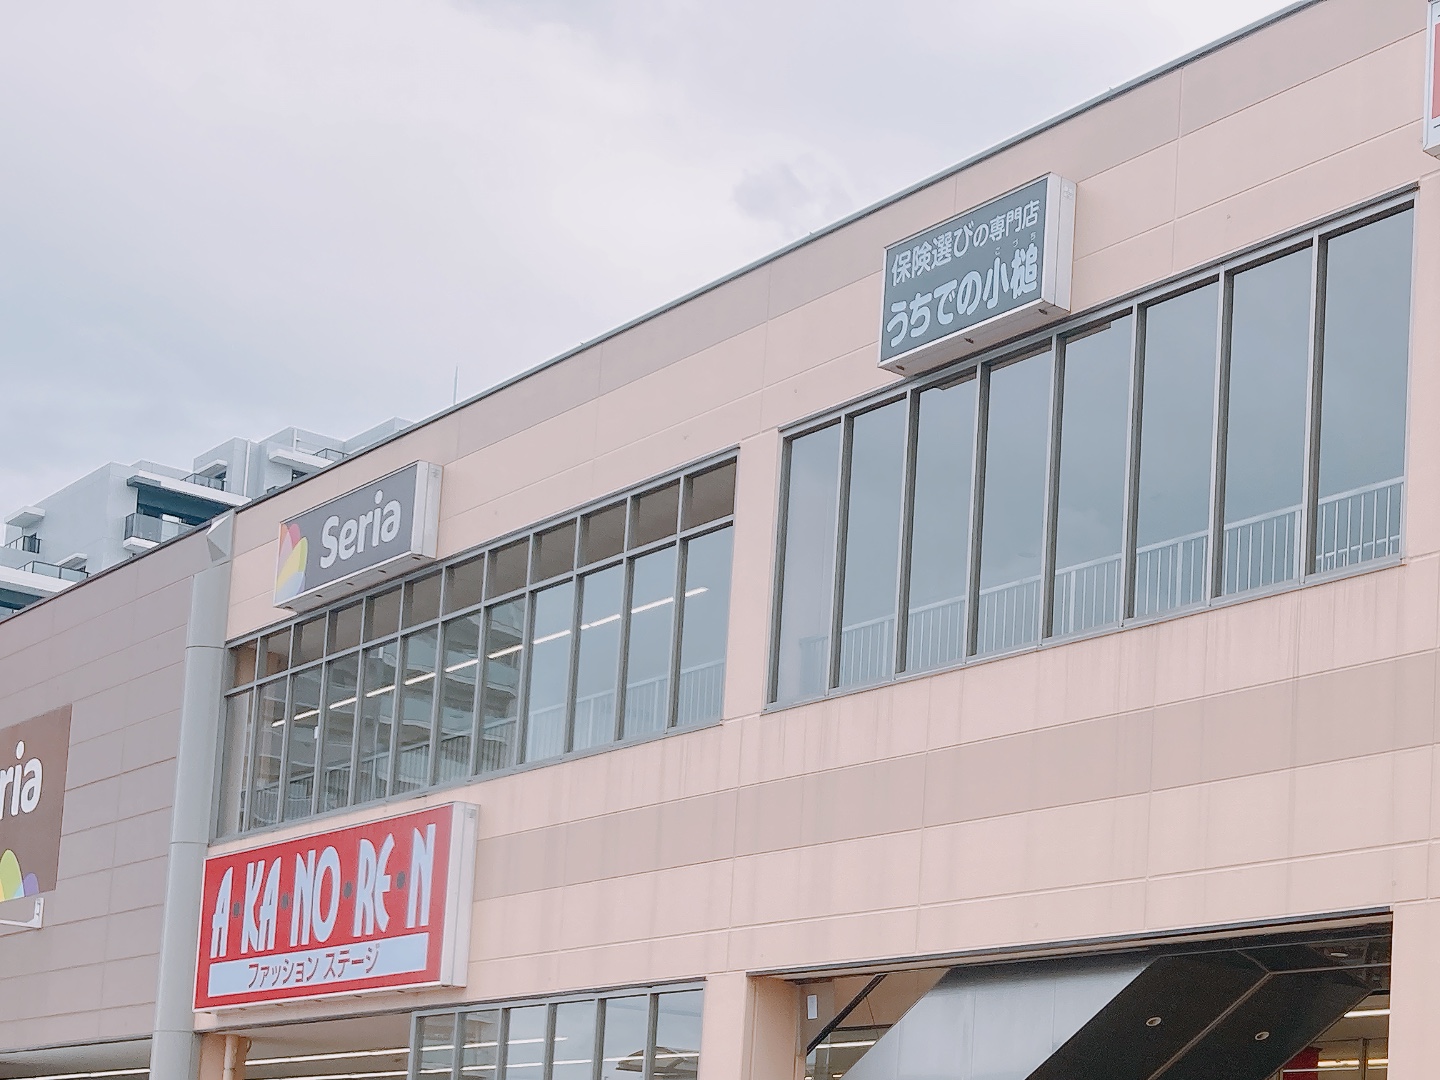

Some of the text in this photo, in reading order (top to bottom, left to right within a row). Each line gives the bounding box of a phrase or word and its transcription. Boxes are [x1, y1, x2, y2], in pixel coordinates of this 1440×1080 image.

[891, 199, 1040, 287] 保険選びの専門店
[886, 242, 1039, 348] うちでの小槌
[320, 489, 401, 569] Seria
[249, 943, 381, 989] ファッション ステージ
